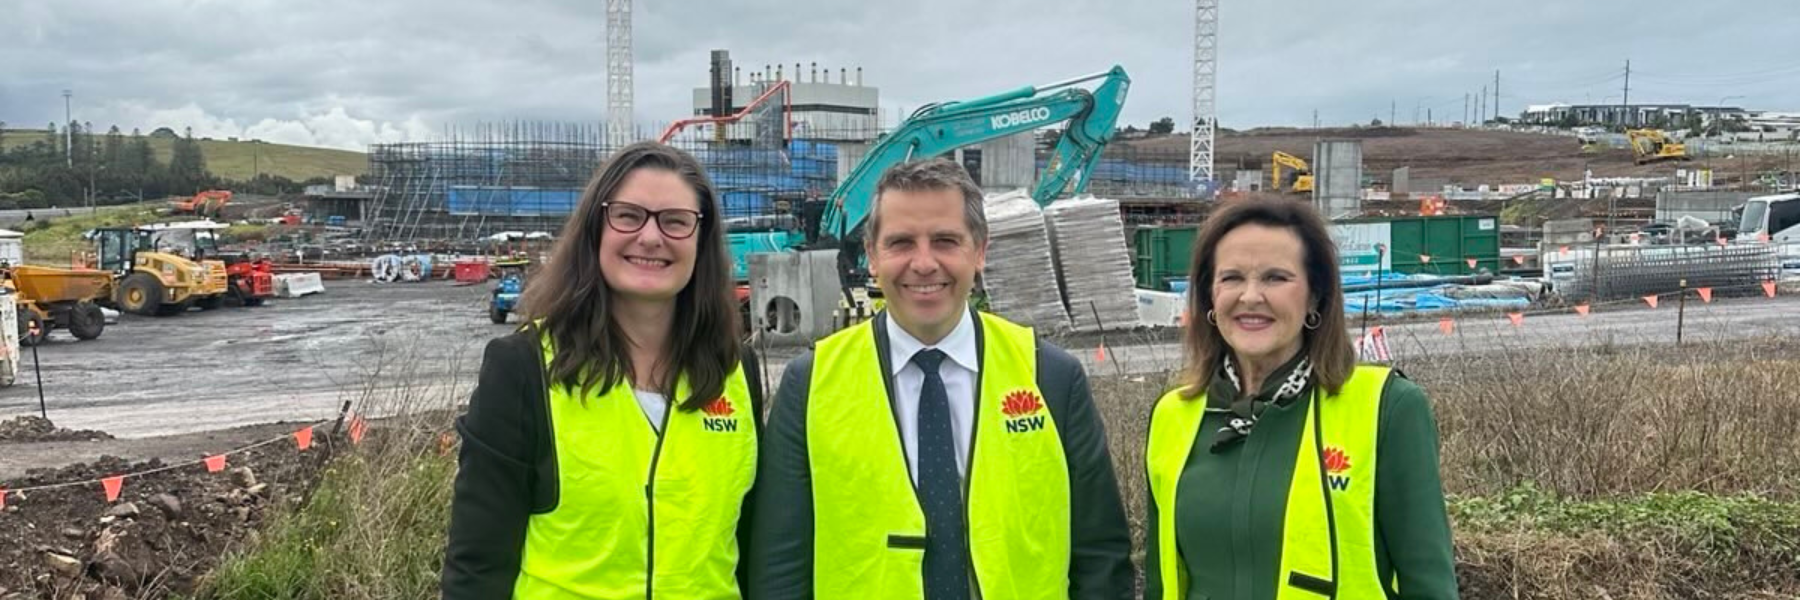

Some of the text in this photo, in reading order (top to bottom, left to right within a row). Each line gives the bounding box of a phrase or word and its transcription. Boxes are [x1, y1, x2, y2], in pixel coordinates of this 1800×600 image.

[991, 106, 1050, 130] KOBELCO
[703, 417, 738, 432] NSW
[1005, 415, 1045, 433] NSW
